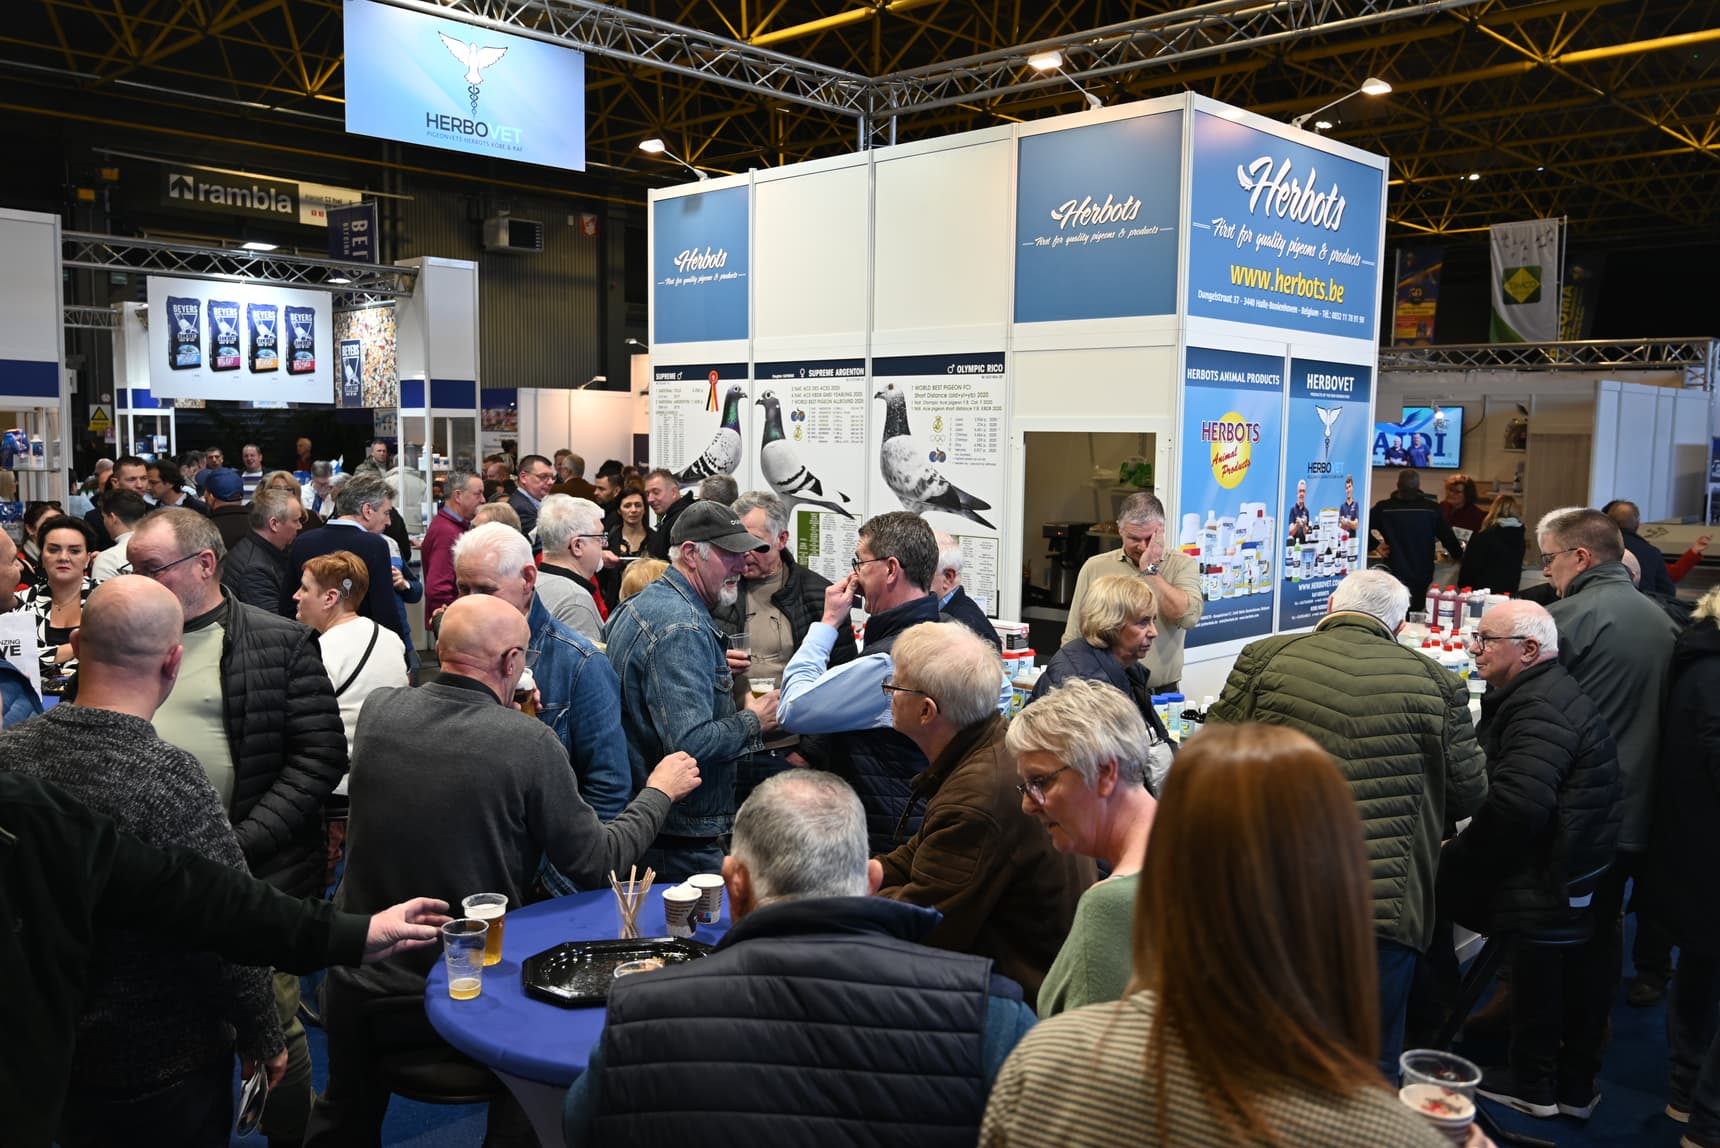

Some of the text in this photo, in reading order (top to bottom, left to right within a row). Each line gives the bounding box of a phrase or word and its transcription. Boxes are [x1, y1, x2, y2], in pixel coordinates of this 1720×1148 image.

[426, 112, 522, 144] HERBOVET
[464, 138, 490, 147] HERBOTS
[198, 183, 292, 214] rambla
[1236, 156, 1346, 232] Herbots
[1050, 193, 1142, 230] Herbots
[1052, 236, 1063, 248] for
[1066, 232, 1089, 246] quality
[1090, 231, 1116, 244] pigeons
[1127, 226, 1159, 239] products
[1212, 217, 1361, 266] First for quality pigeons & products
[674, 246, 728, 273] Herbots
[1230, 264, 1345, 303] www.herbots.be
[173, 304, 198, 313] BEYERS
[213, 307, 238, 316] BEYERS
[290, 314, 312, 322] BEYERS
[808, 368, 864, 377] SUPREME ARGENTON
[957, 364, 1003, 373] OLYMPIC RICO
[1187, 368, 1280, 385] HERBOTS ANIMAL PRODUCTS
[1307, 374, 1354, 392] HERBOVET
[1202, 421, 1260, 442] HERBOTS
[1212, 447, 1238, 467] Animal
[1222, 458, 1251, 478] Products
[1307, 462, 1344, 474] HERBOVET
